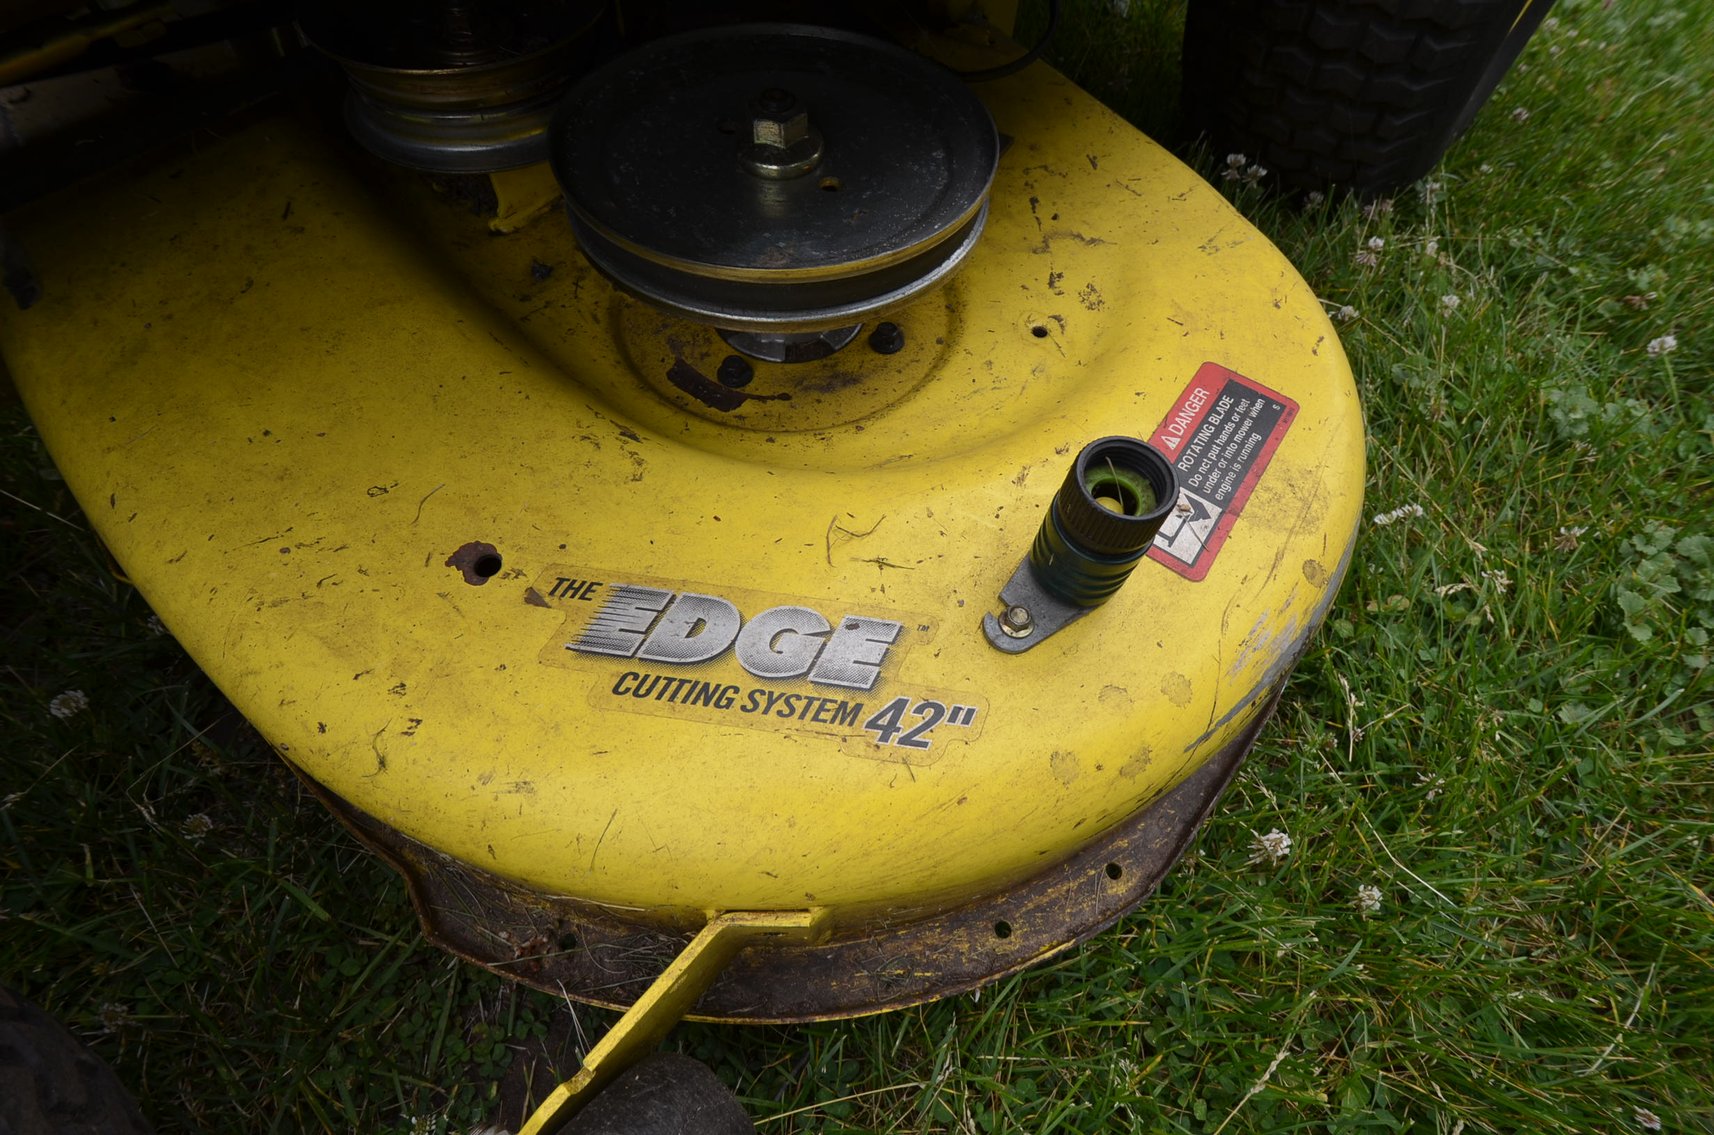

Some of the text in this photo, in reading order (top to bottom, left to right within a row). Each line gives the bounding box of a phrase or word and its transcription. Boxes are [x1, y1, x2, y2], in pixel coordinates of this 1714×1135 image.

[1169, 387, 1210, 436] DANGER
[1232, 413, 1241, 422] or
[1235, 398, 1250, 413] feet
[1178, 395, 1234, 472] ROTATING BLADE
[1203, 398, 1265, 493] under or into mower when
[1215, 421, 1236, 446] hands
[1208, 445, 1221, 460] put
[1215, 432, 1262, 500] engine is running
[1188, 474, 1202, 487] Do
[548, 577, 603, 601] THE
[563, 583, 903, 691] EDGE
[612, 671, 978, 750] CUTTING SYSTEM 42"
